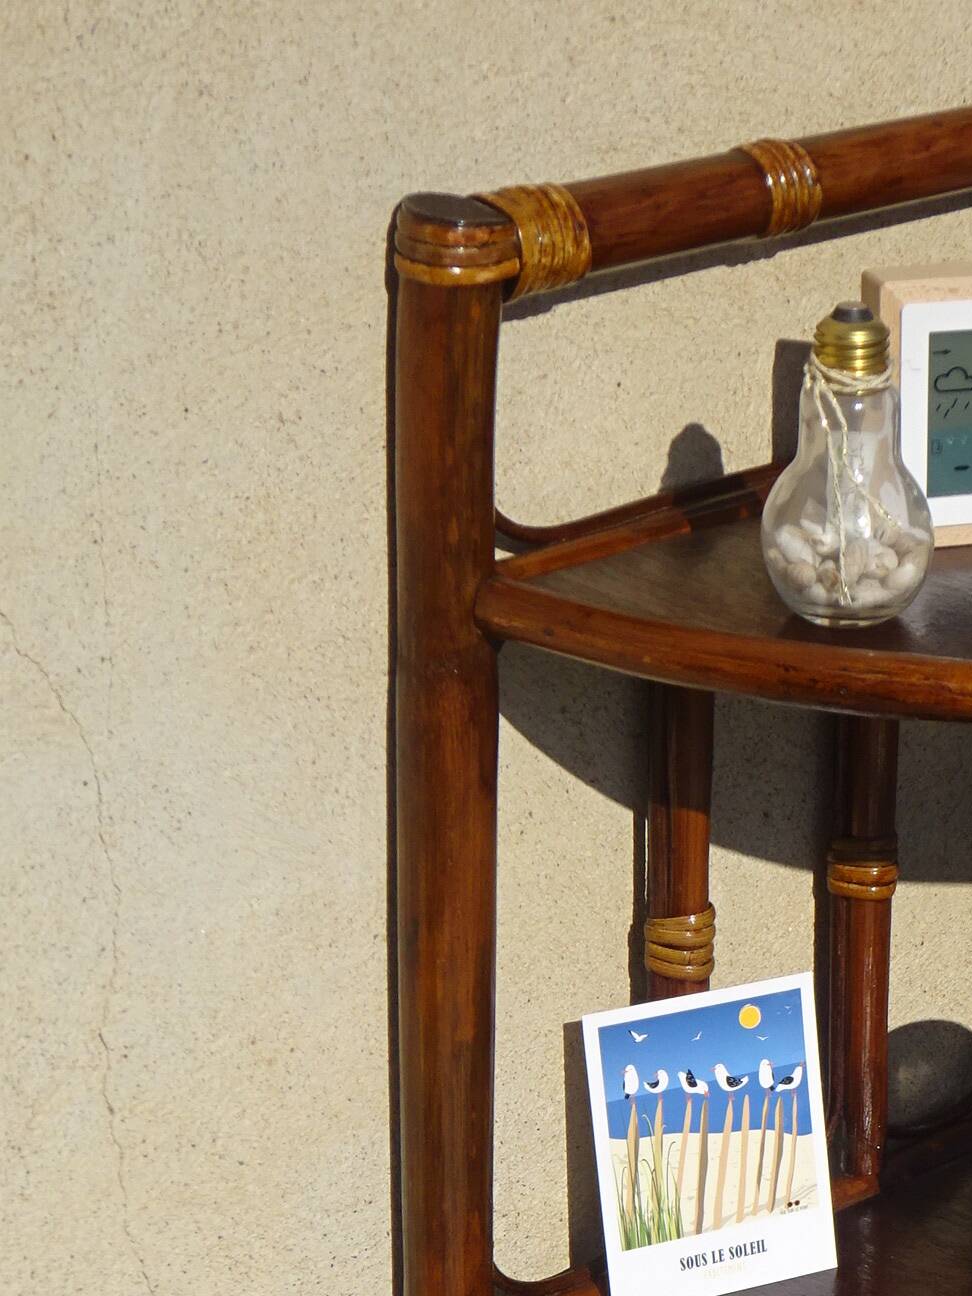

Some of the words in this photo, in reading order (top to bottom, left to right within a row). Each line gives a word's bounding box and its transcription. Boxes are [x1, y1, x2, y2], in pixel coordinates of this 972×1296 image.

[680, 1252, 709, 1271] SOUS
[711, 1248, 726, 1264] LE
[729, 1239, 768, 1260] SOLEIL
